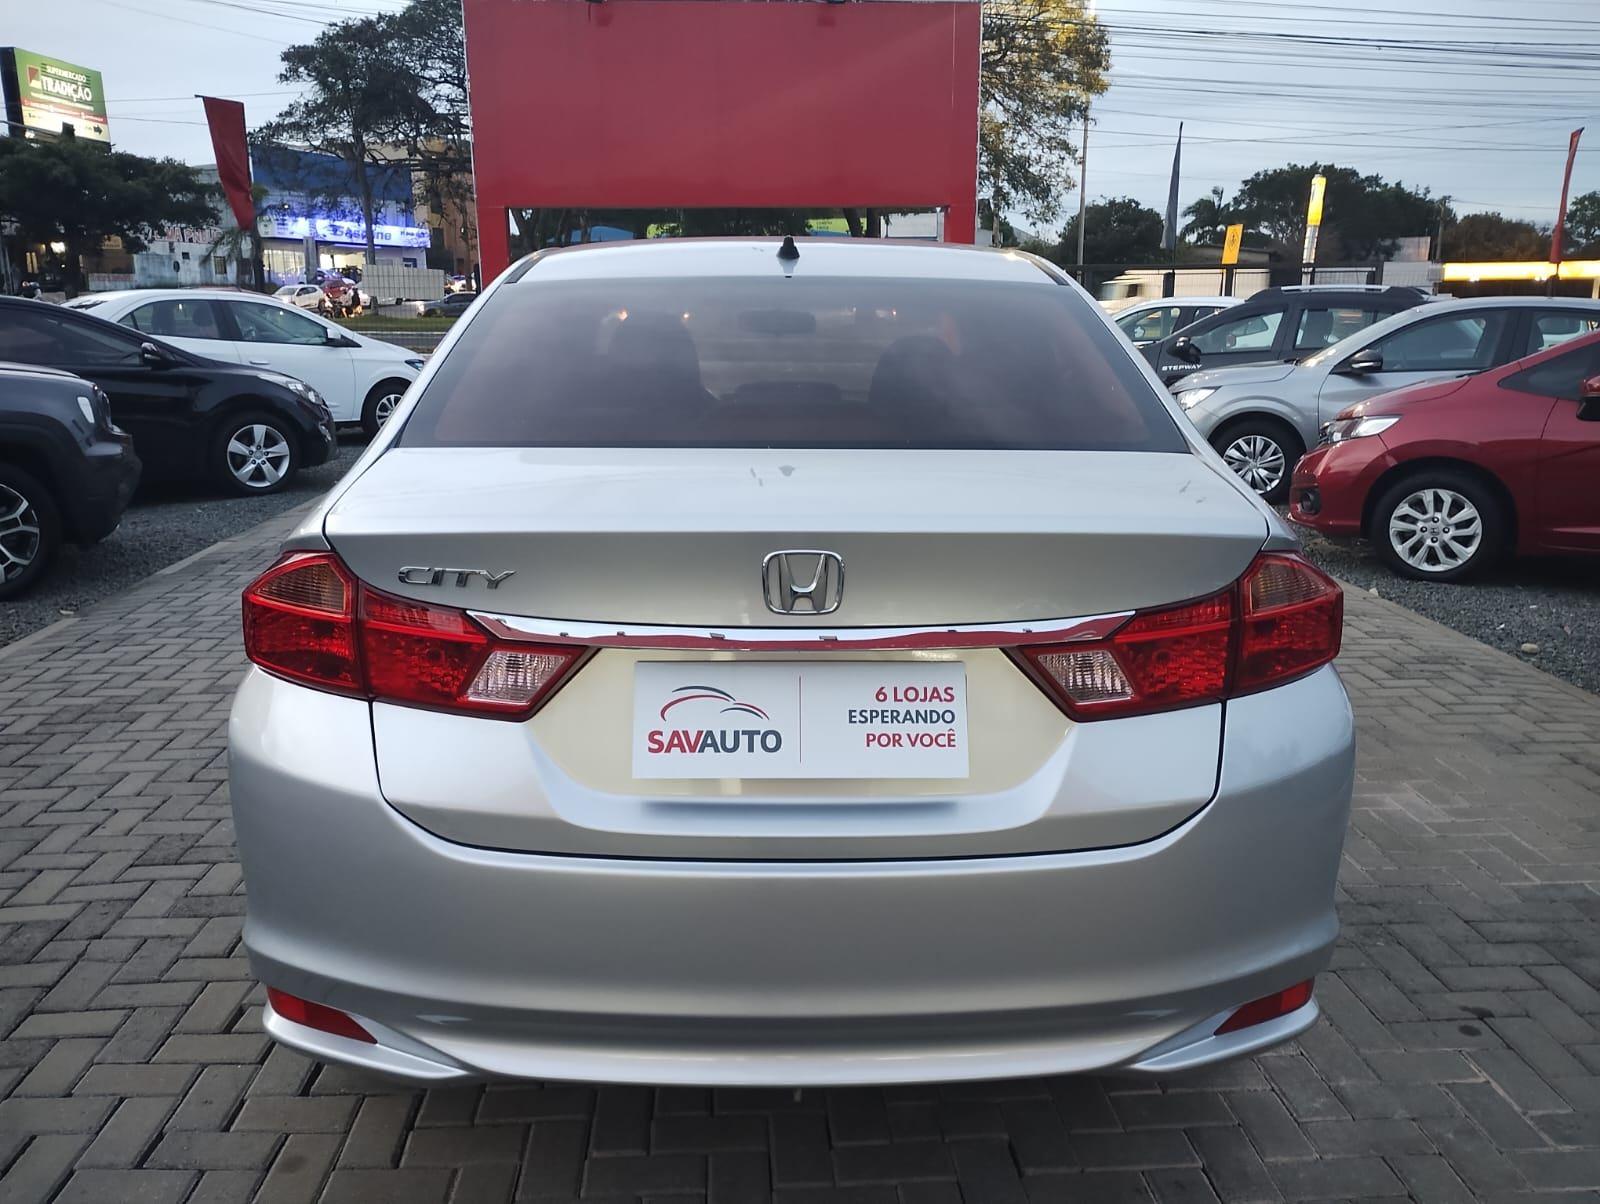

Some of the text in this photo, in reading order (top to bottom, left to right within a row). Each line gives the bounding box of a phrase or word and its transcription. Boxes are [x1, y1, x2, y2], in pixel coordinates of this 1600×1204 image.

[46, 65, 87, 82] SUPERMERCADO
[42, 77, 92, 102] TRADIÇÃO
[1161, 364, 1203, 372] STEPWAY
[397, 565, 517, 590] CITY
[874, 686, 955, 703] 6 LOJAS
[848, 709, 956, 725] ESPERANDO
[647, 729, 782, 754] SAVAUTO
[865, 728, 957, 748] POR VOCÊ
